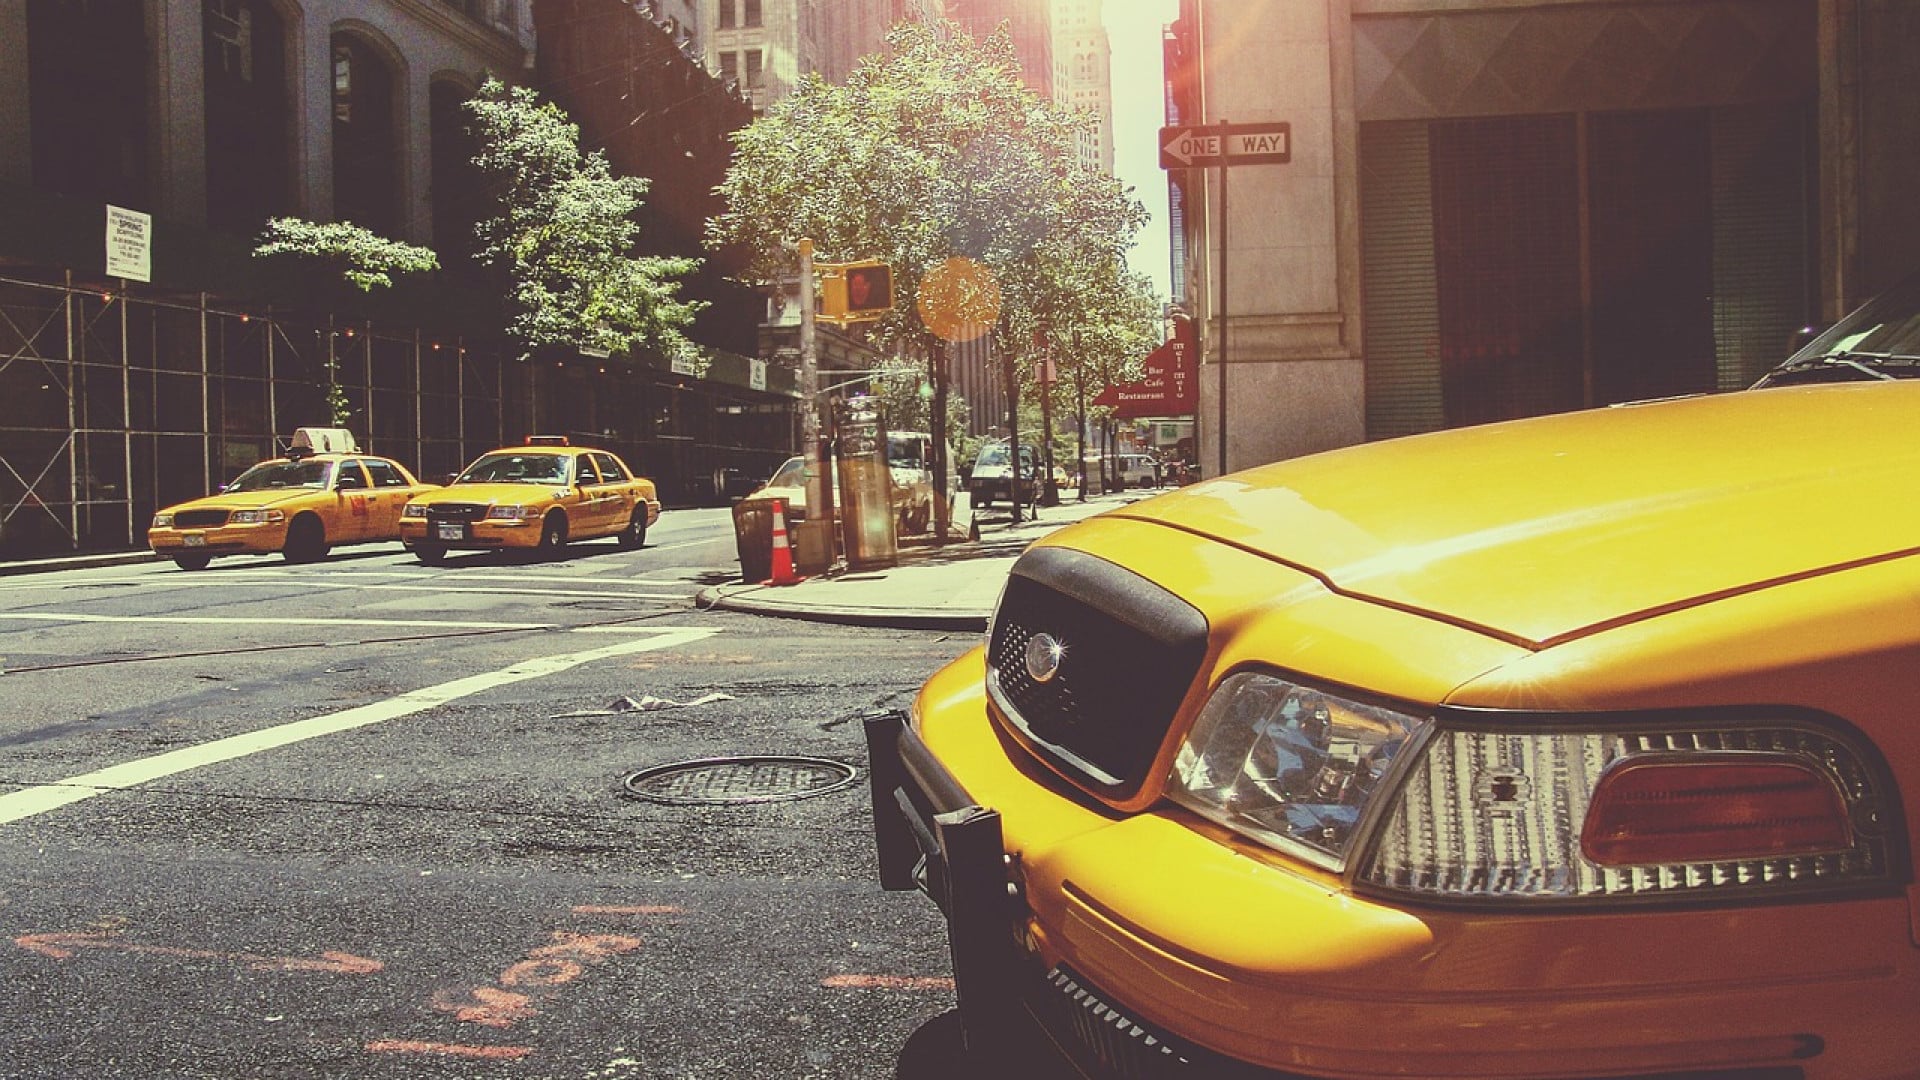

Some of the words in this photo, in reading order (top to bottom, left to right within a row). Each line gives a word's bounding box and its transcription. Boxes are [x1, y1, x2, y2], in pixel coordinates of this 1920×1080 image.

[1180, 138, 1218, 155] ONE
[1242, 135, 1280, 152] WAY
[1148, 367, 1164, 375] Bar
[1118, 392, 1165, 400] Restaurant
